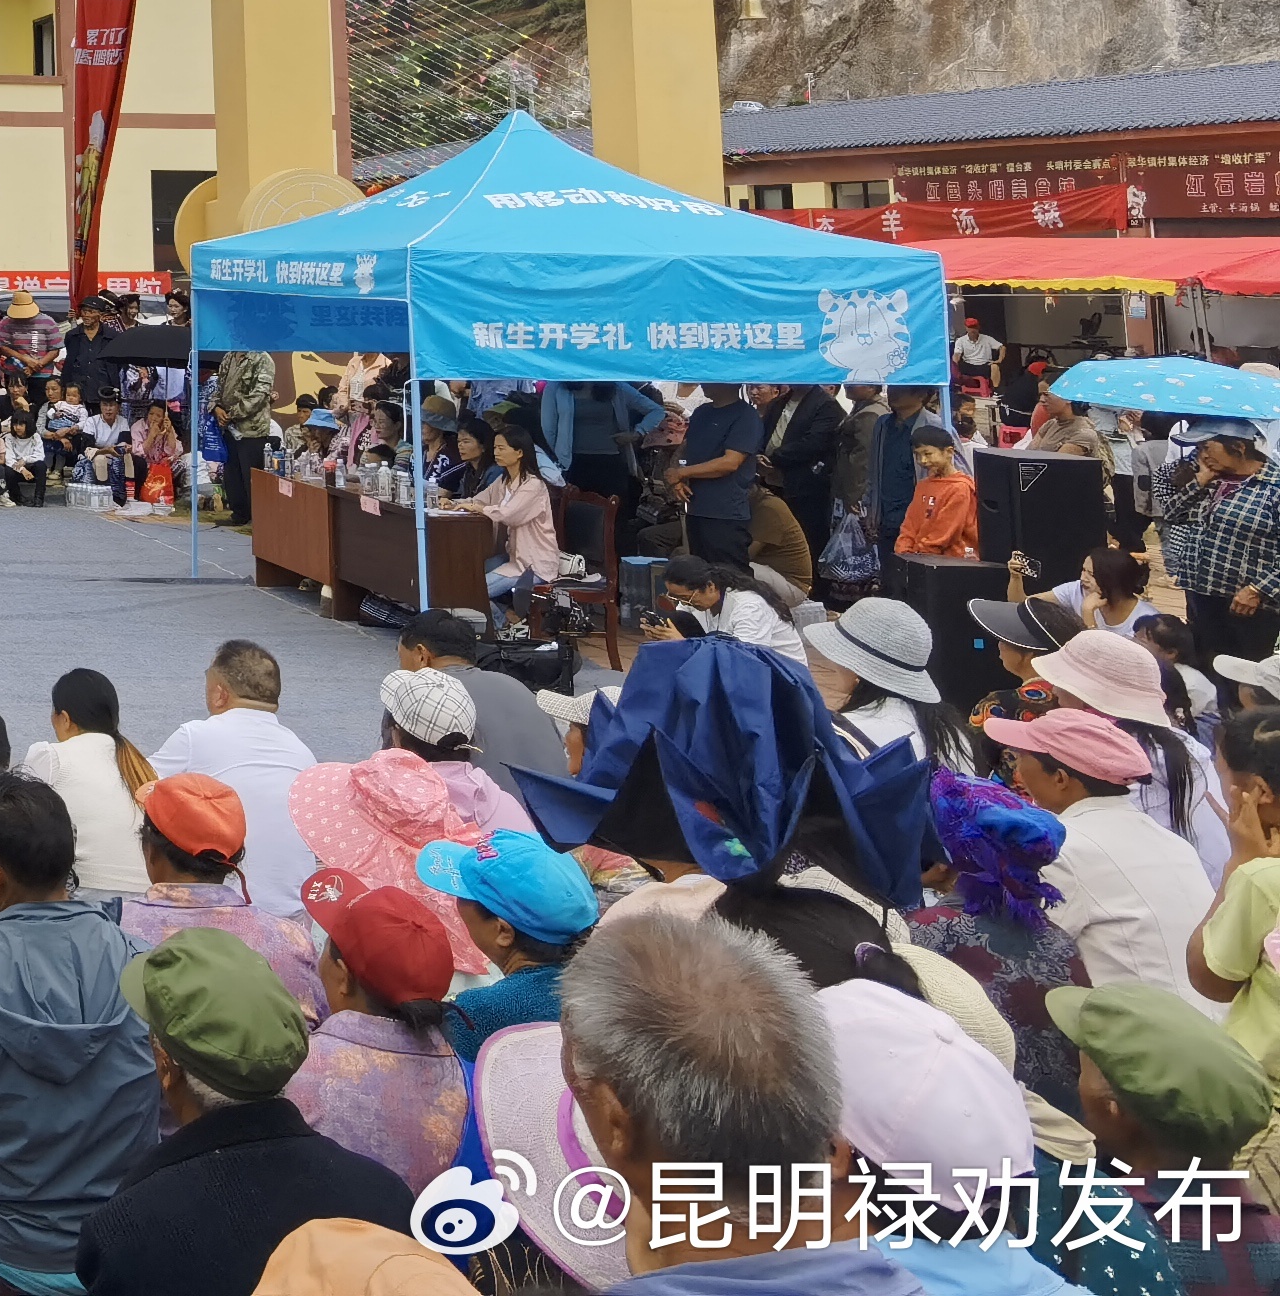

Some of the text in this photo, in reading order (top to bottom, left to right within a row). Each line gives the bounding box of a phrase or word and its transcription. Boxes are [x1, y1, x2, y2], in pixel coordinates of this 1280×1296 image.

[1185, 170, 1280, 197] 红石岩
[209, 258, 346, 287] 新生开学礼 快到我这里
[471, 321, 806, 351] 新生开学礼 快到我这里
